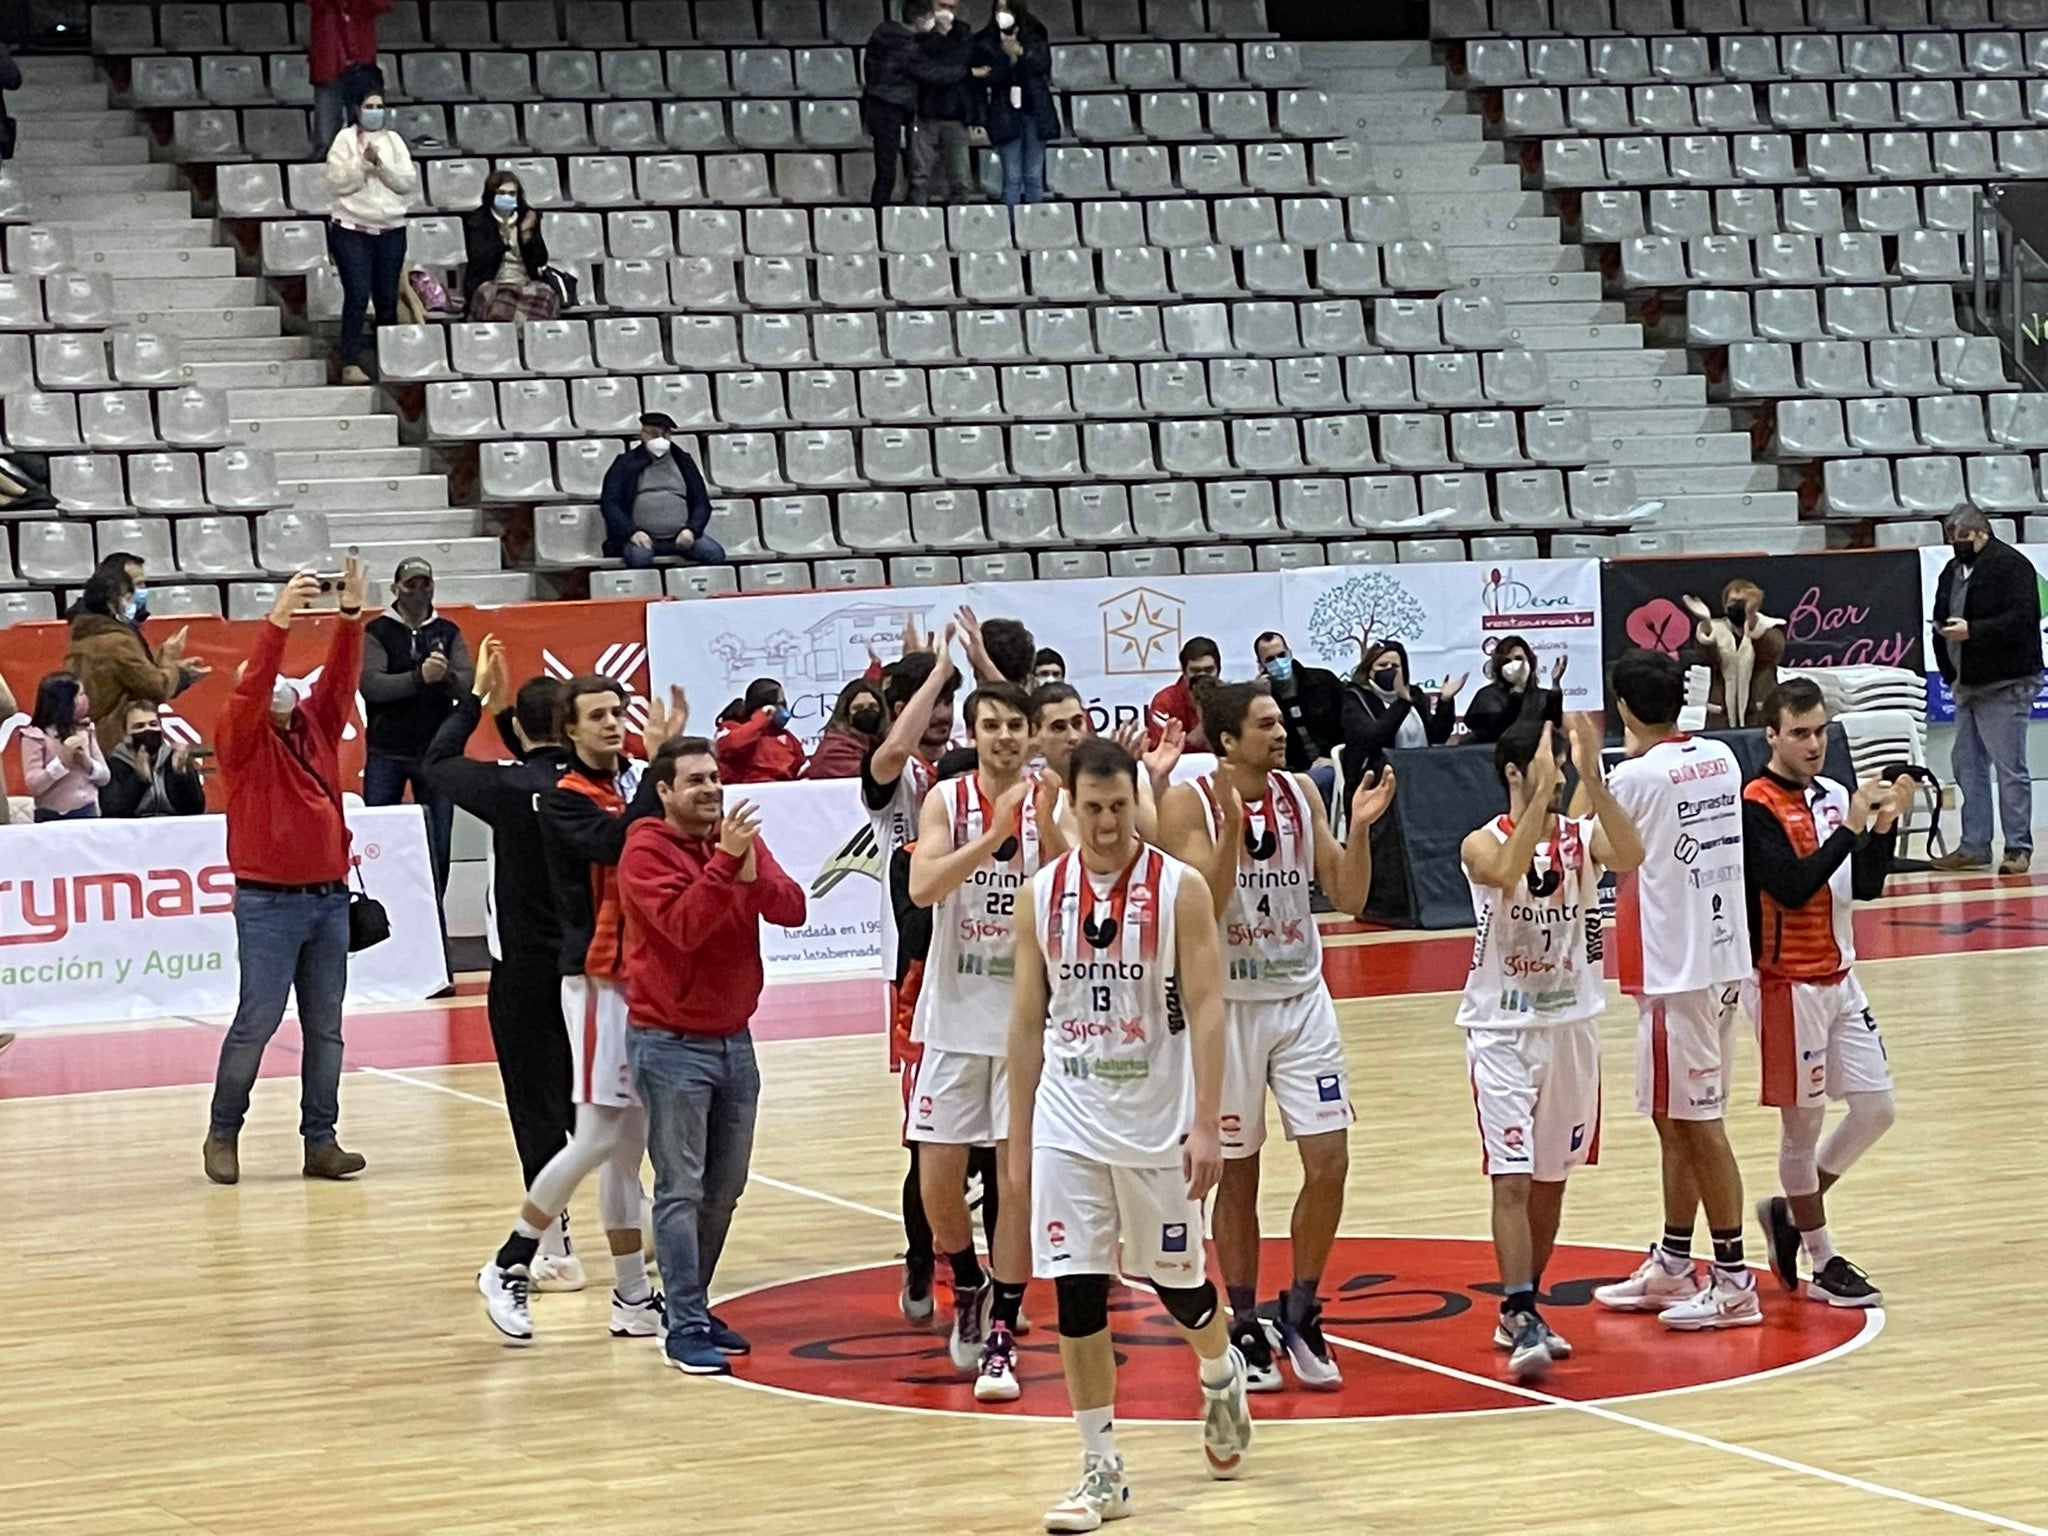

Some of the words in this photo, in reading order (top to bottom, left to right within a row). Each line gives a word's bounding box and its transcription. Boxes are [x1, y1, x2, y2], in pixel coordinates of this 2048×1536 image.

[1787, 587, 1870, 640] Bar
[986, 892, 1014, 915] 22
[1257, 894, 1270, 916] 4
[840, 926, 856, 935] en
[1542, 930, 1551, 951] 7
[115, 958, 133, 984] y
[143, 950, 222, 979] Agua
[1092, 986, 1111, 1012] 13
